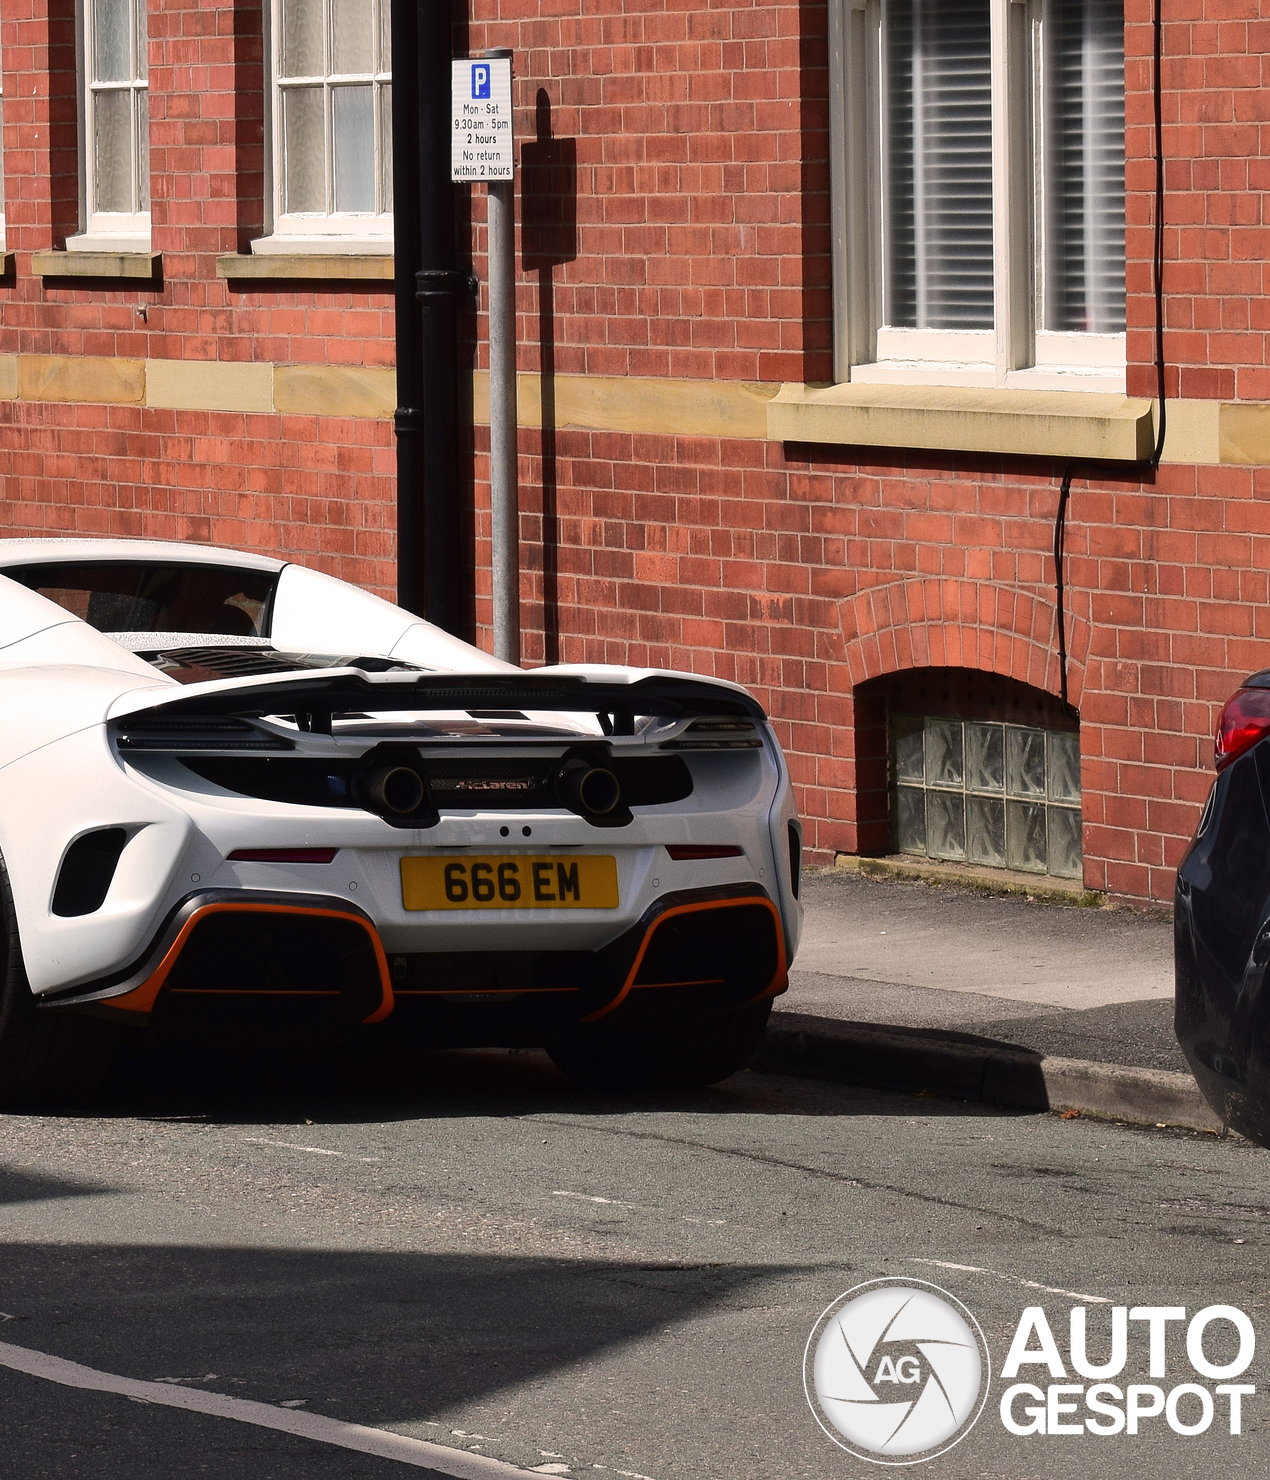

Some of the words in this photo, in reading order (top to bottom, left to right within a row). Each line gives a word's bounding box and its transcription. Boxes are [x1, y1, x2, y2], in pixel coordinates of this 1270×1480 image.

[475, 67, 487, 95] P
[463, 103, 479, 114] Mon
[486, 103, 499, 114] Sat
[454, 119, 484, 130] 9.30am
[491, 119, 509, 131] 5pm
[467, 134, 473, 144] 2
[475, 134, 497, 144] hours
[462, 150, 474, 161] No
[476, 151, 501, 161] return
[453, 165, 477, 176] within
[480, 165, 486, 175] 2
[488, 165, 511, 175] hours
[455, 781, 528, 790] McLaren
[444, 862, 521, 902] 666
[531, 862, 581, 901] EM
